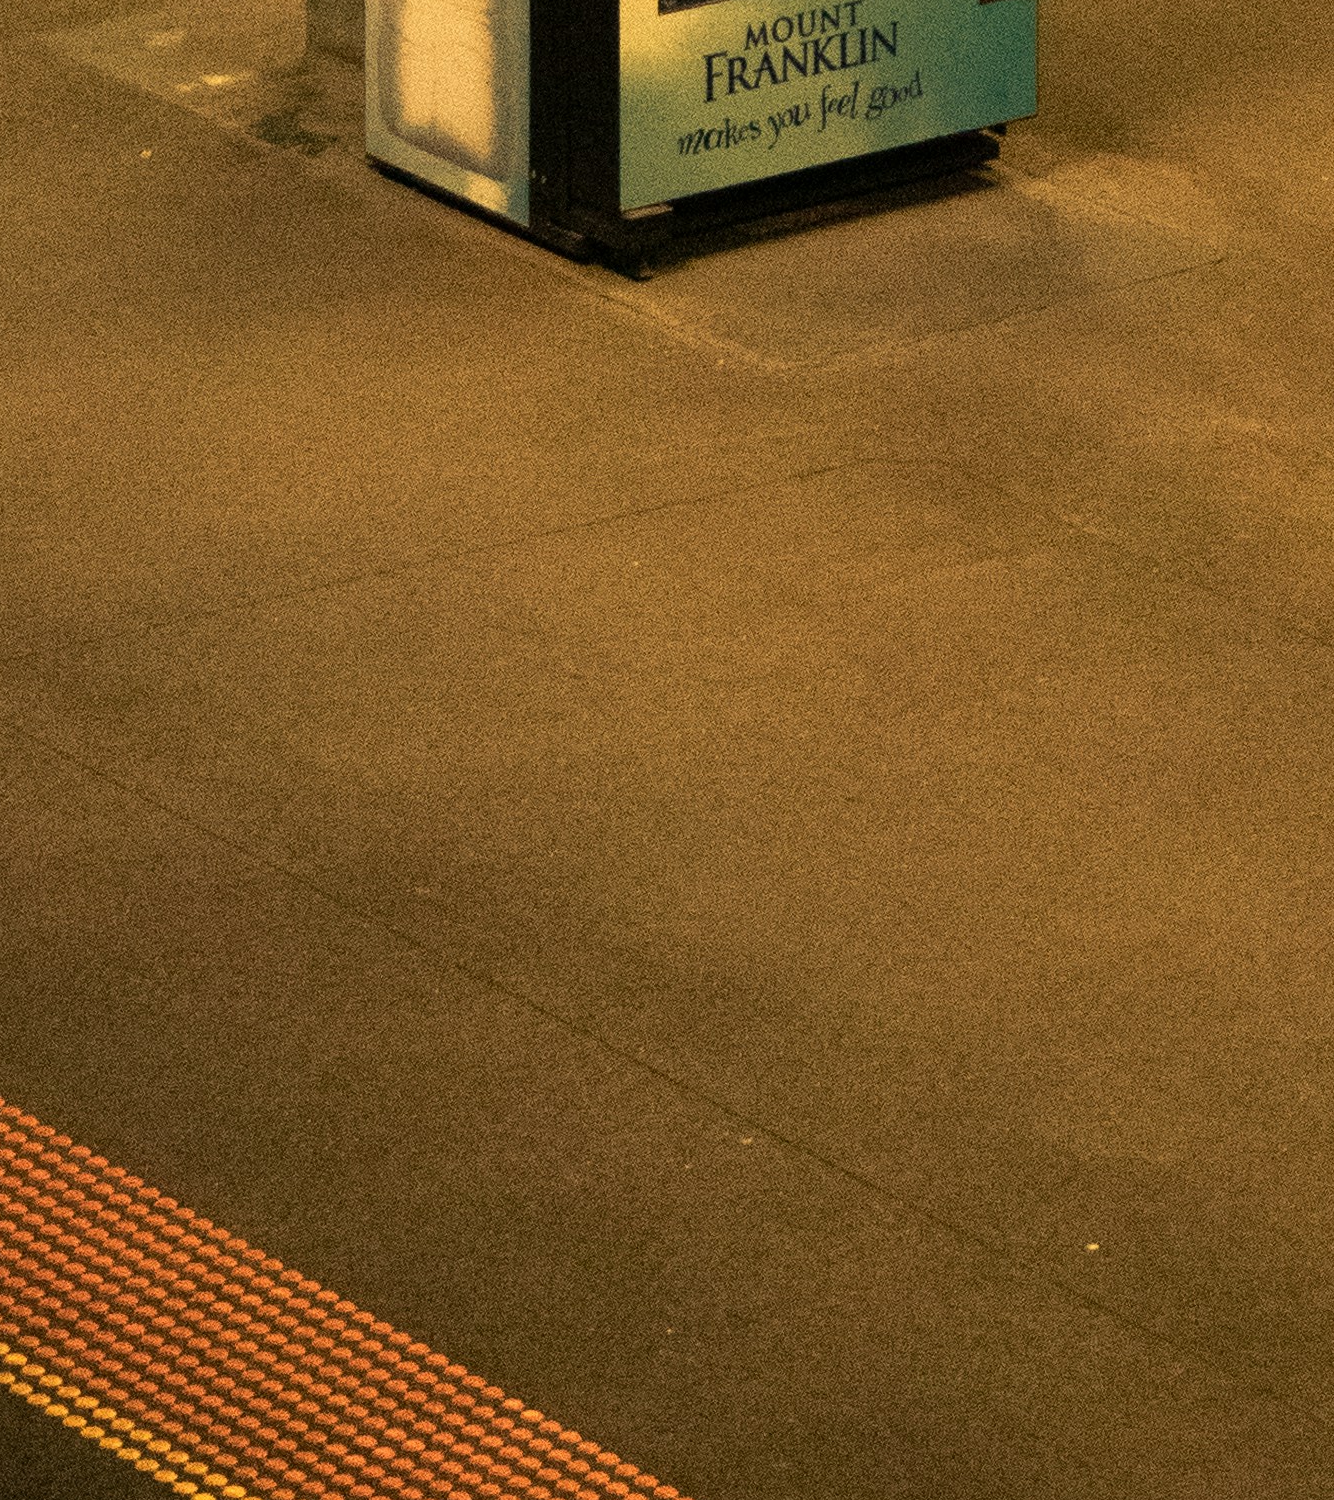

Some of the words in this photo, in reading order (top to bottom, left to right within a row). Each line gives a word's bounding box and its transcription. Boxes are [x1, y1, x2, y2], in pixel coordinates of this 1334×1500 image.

[703, 20, 899, 104] FRANKLIN
[744, 0, 863, 51] MOUNT
[677, 118, 762, 156] makes
[766, 101, 811, 150] you
[817, 80, 860, 133] feel
[865, 68, 924, 120] good
